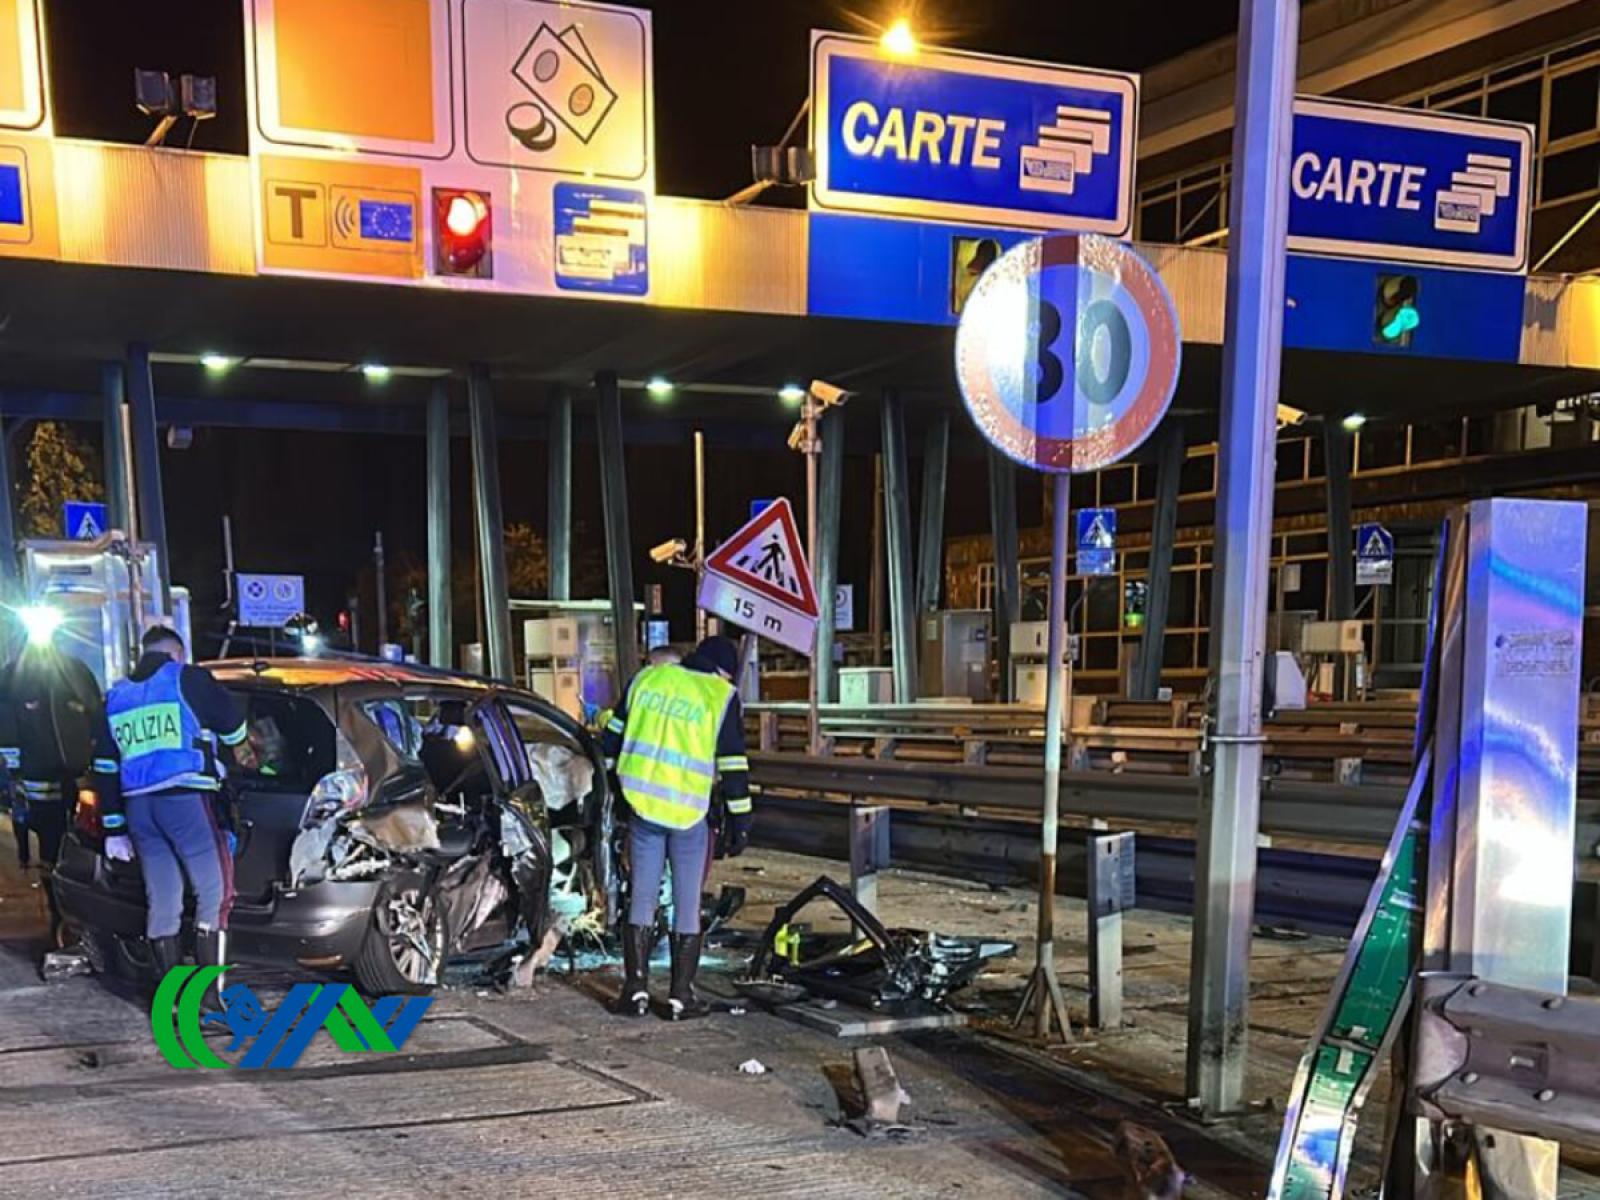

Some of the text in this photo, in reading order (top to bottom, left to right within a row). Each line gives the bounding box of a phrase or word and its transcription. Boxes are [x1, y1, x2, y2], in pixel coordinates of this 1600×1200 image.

[842, 101, 1006, 169] CARTE
[1291, 152, 1427, 211] CARTE
[274, 187, 317, 239] T
[734, 598, 782, 632] 15 m
[114, 713, 179, 746] POLIZIA
[637, 688, 706, 727] POLIZIA
